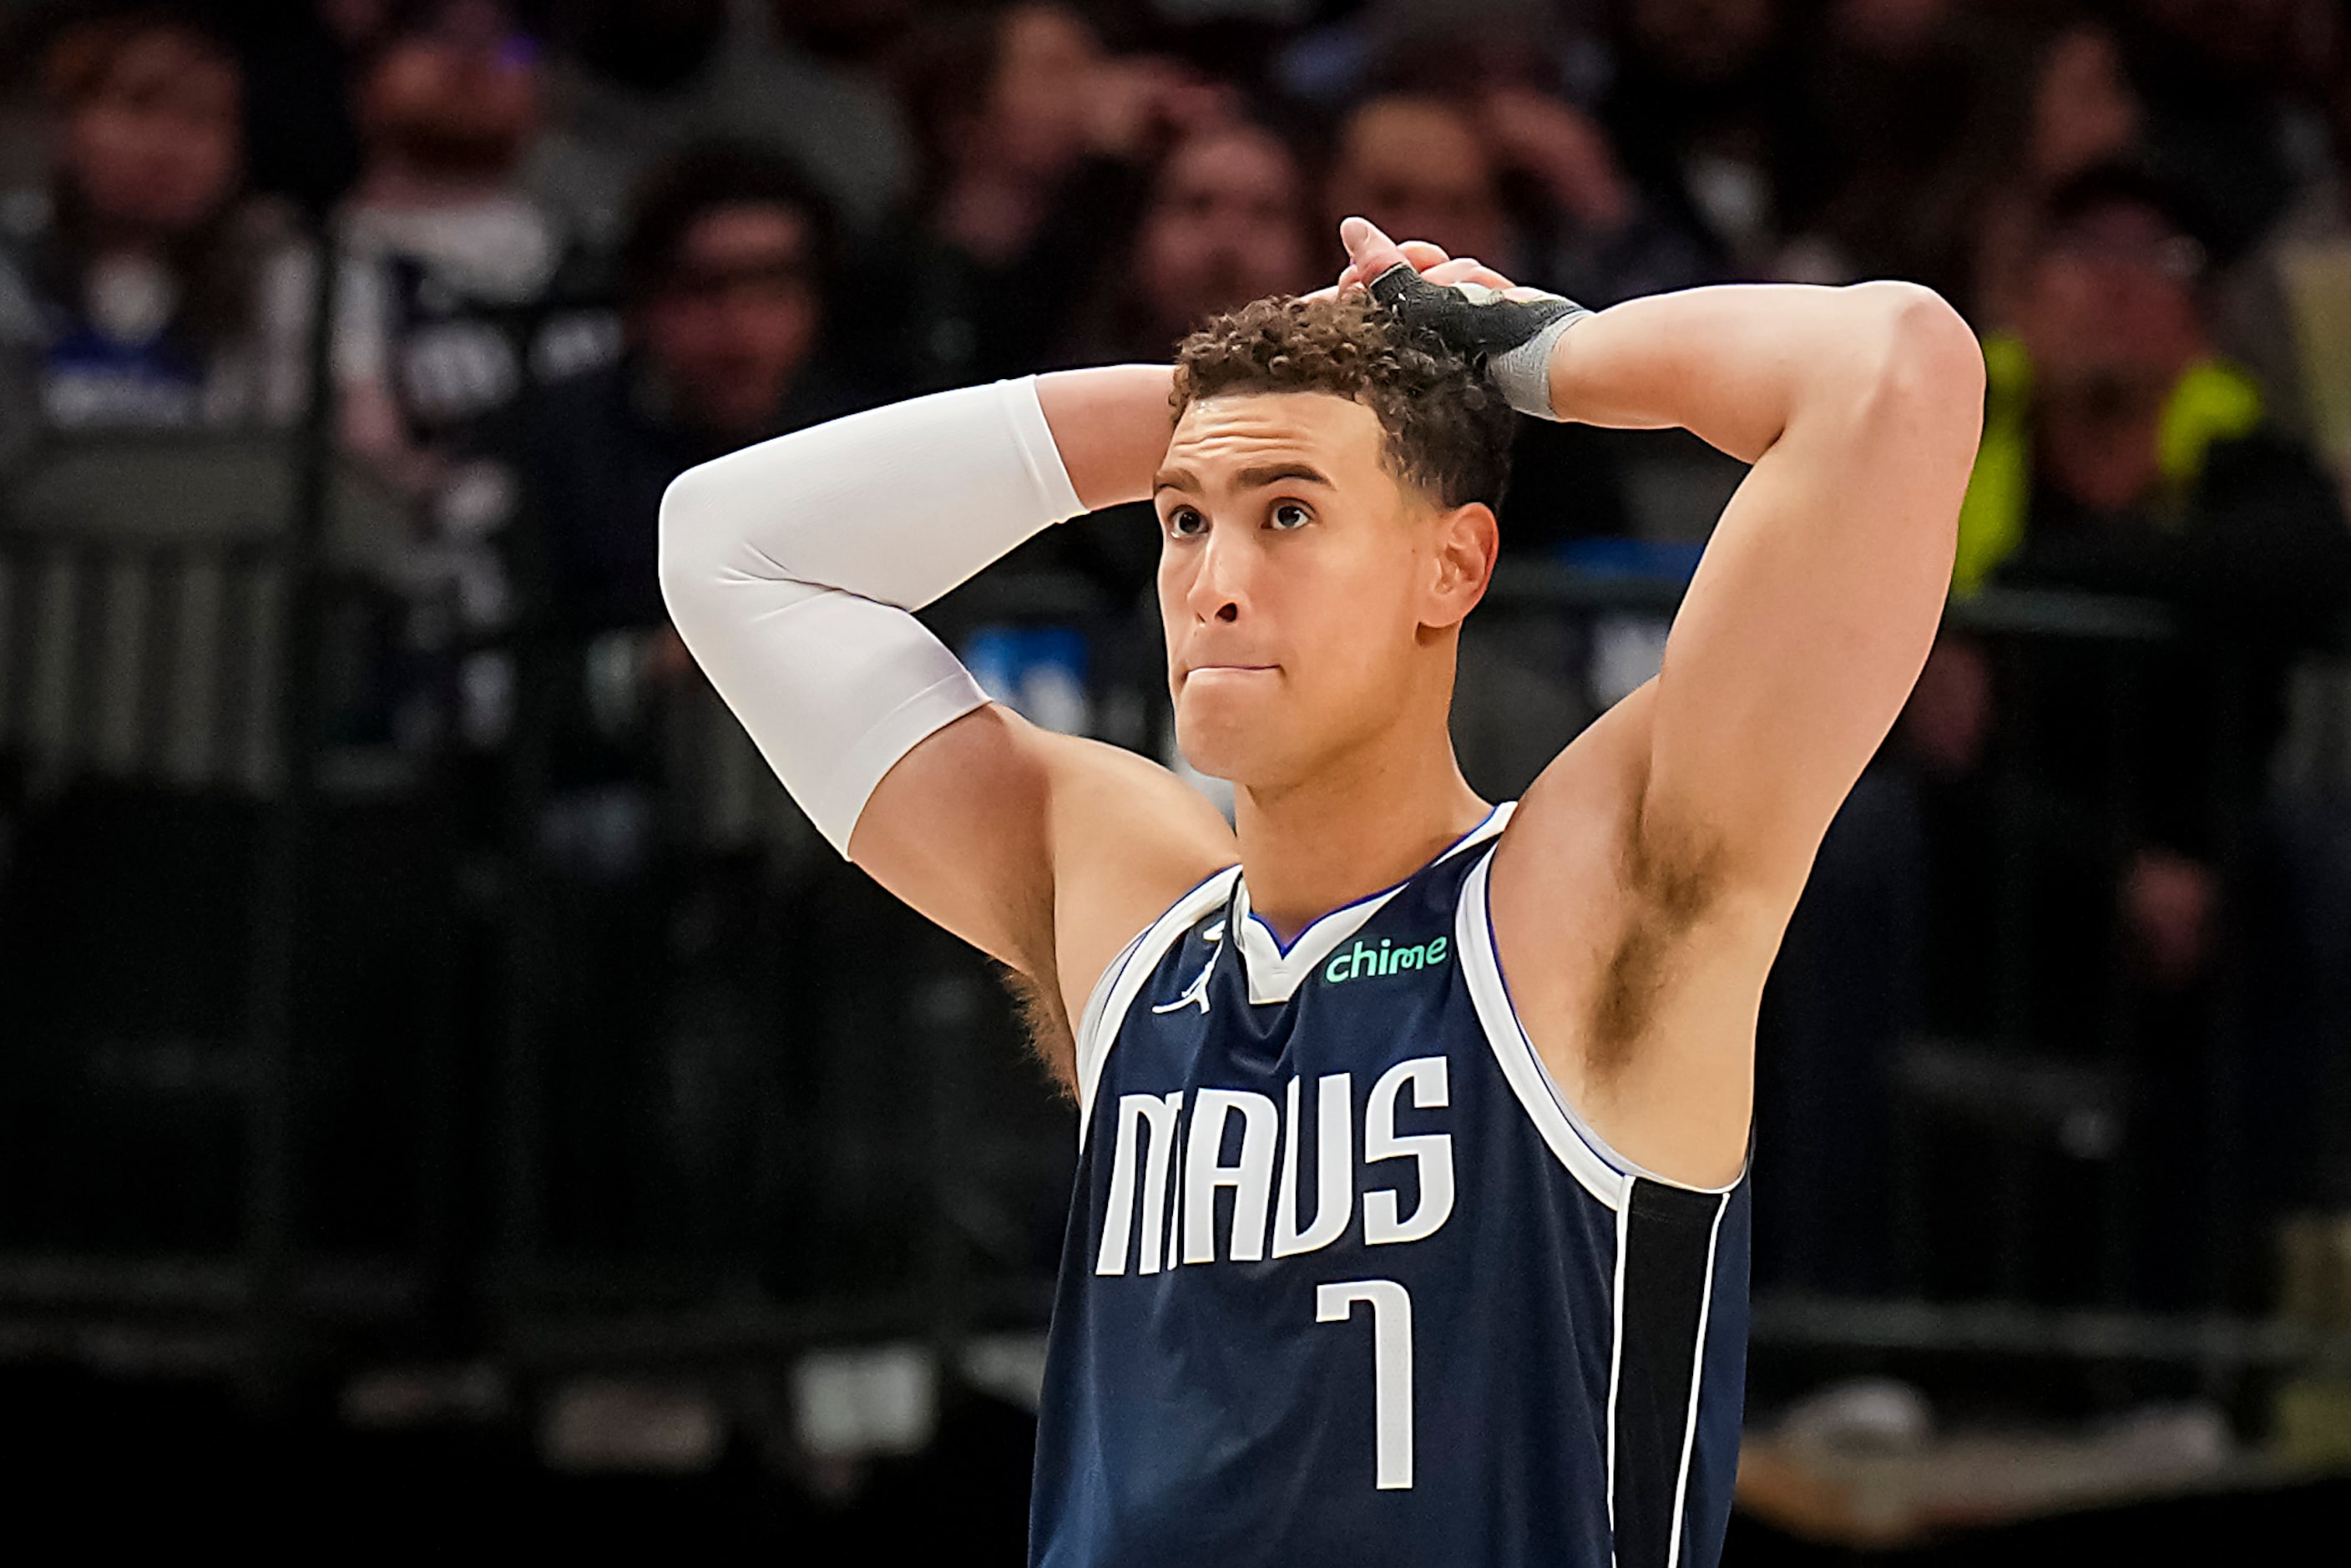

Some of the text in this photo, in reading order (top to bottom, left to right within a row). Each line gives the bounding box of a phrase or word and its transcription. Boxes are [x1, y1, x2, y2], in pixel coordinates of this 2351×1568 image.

[1326, 937, 1447, 983] chime
[1095, 1056, 1454, 1276] MAVS
[1316, 1280, 1413, 1490] 7
